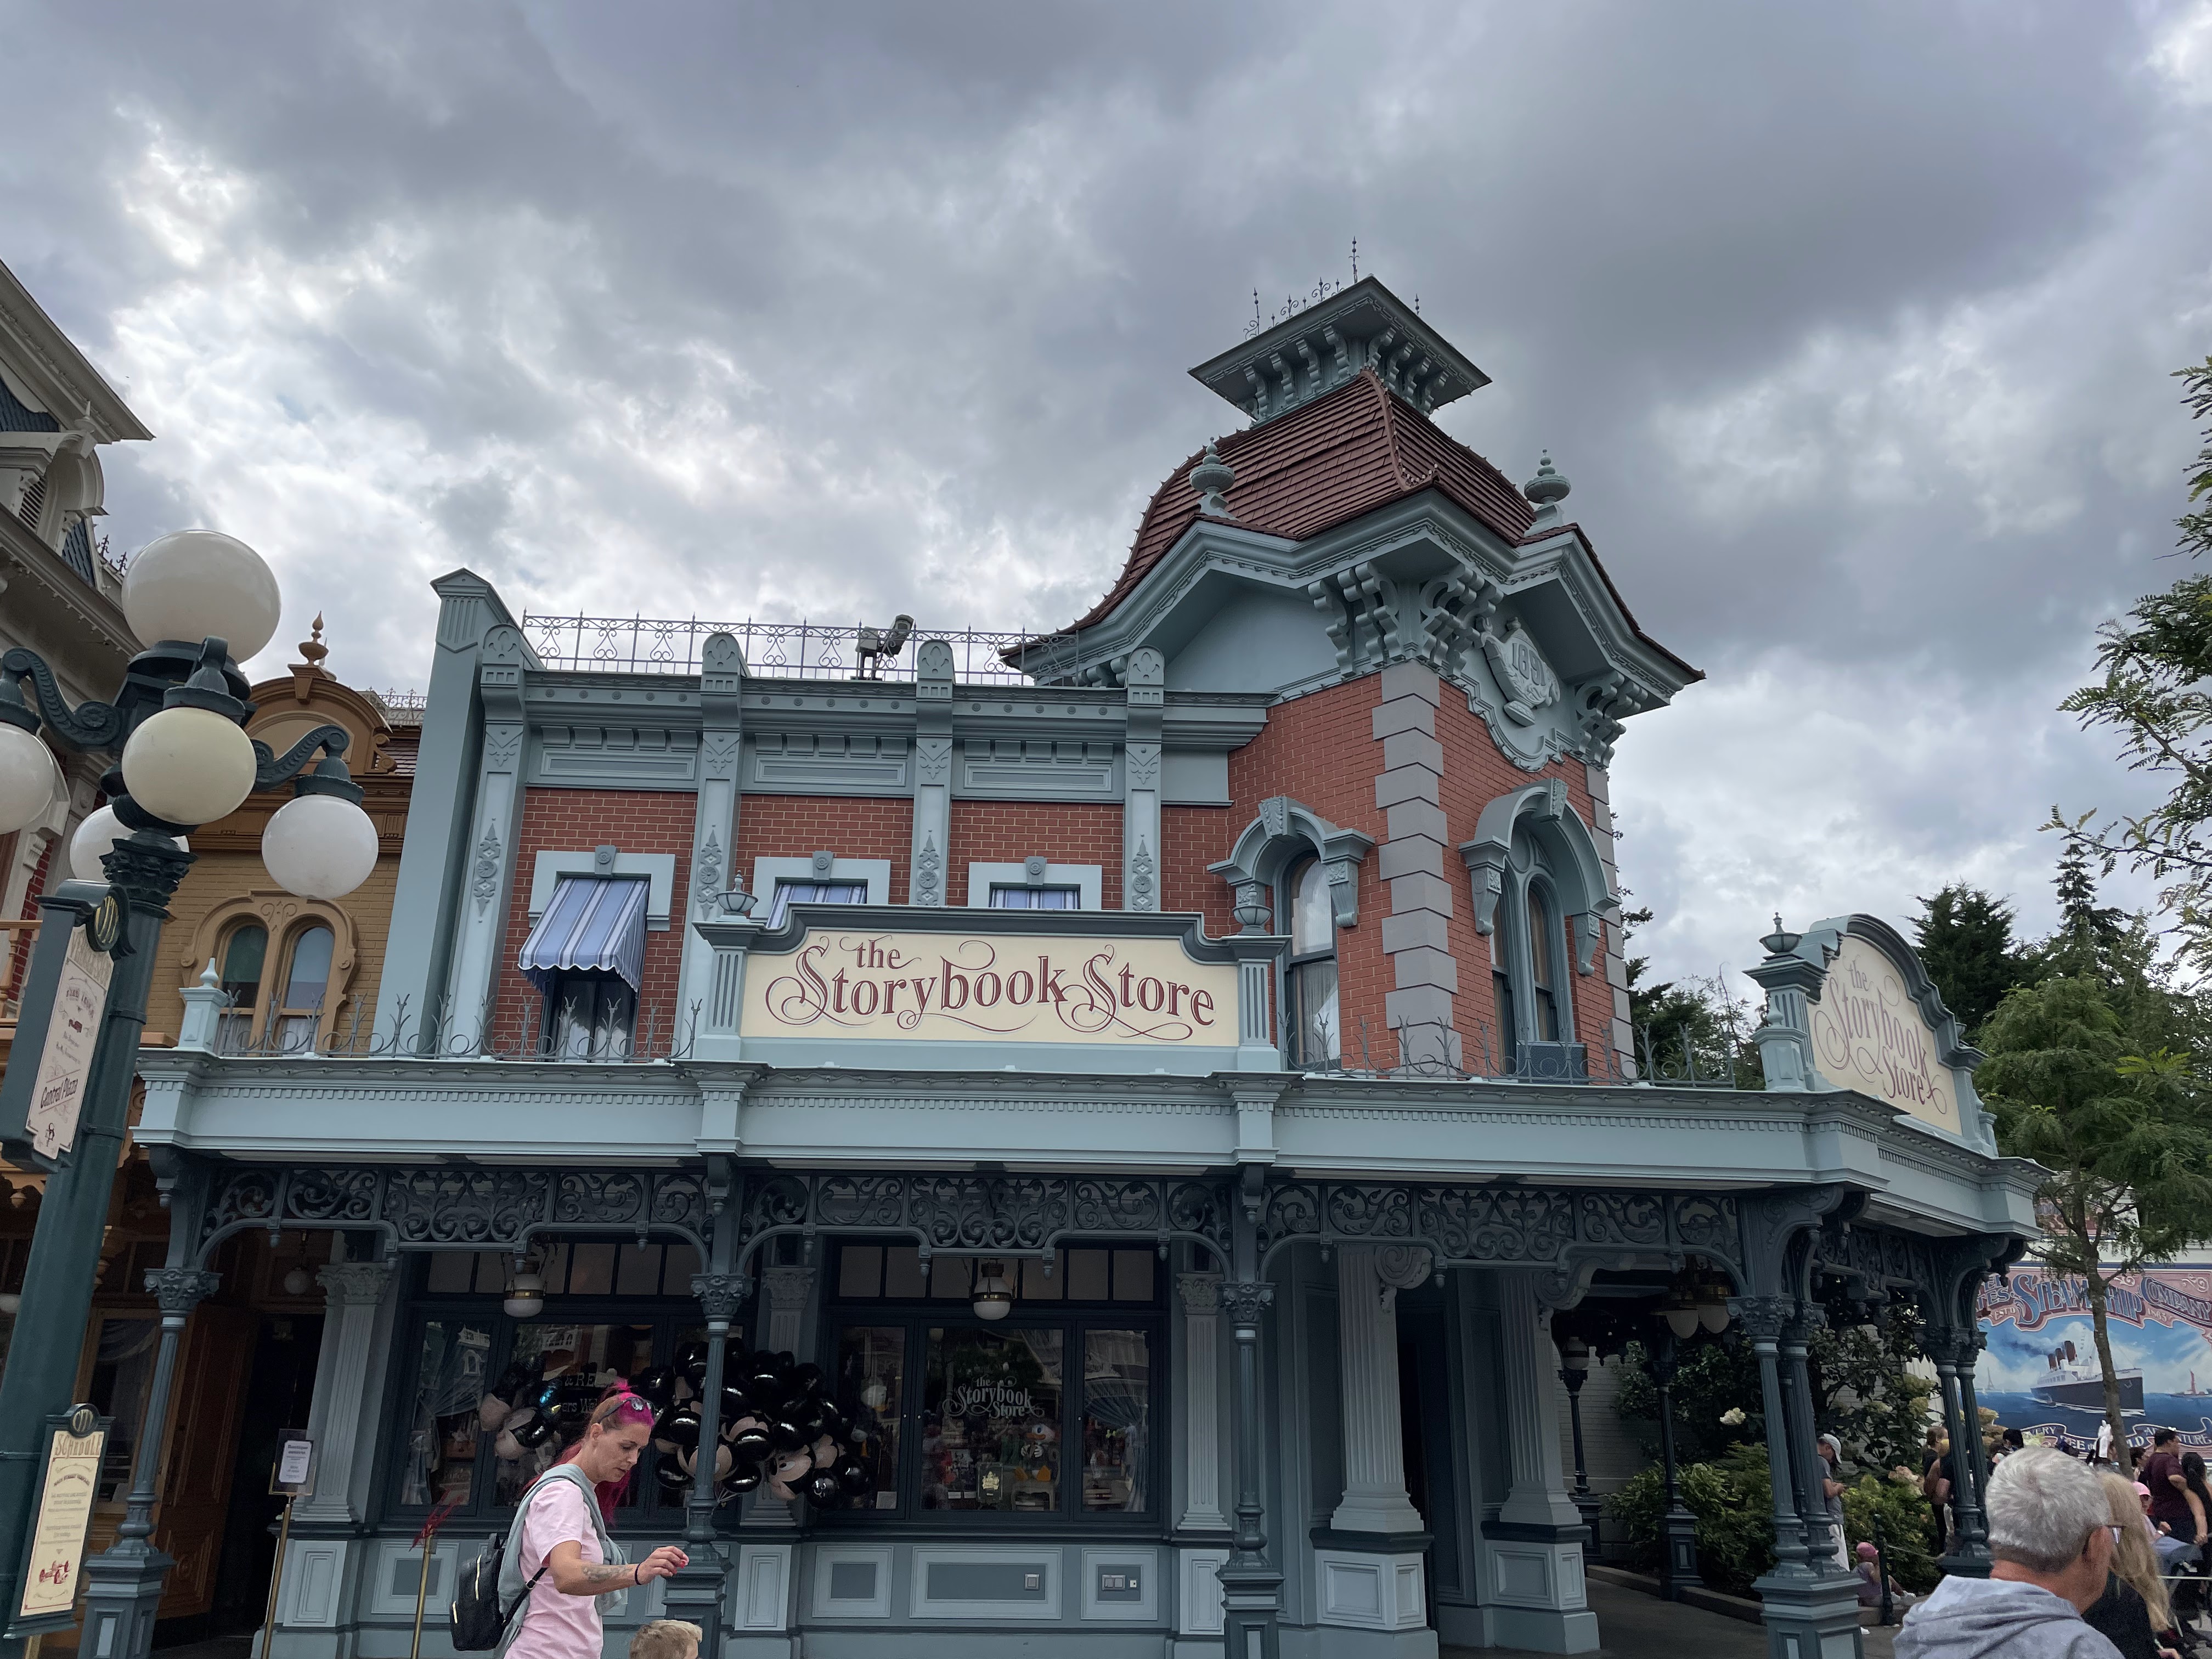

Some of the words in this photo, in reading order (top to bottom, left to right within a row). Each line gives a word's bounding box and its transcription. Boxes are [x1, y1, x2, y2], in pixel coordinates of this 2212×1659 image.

[1513, 642, 1546, 686] 1891
[839, 934, 922, 969] the
[766, 935, 1065, 1032] Storybook
[1056, 944, 1215, 1041] Store
[1843, 955, 1874, 991] the
[1815, 969, 1946, 1114] Storybook
[1882, 1045, 1926, 1105] Store
[2011, 1274, 2143, 1325] STEAMHIP
[2141, 1276, 2211, 1321] COMPANY
[942, 1376, 1045, 1417] Storybook
[973, 1374, 996, 1387] the
[989, 1401, 1026, 1419] Store
